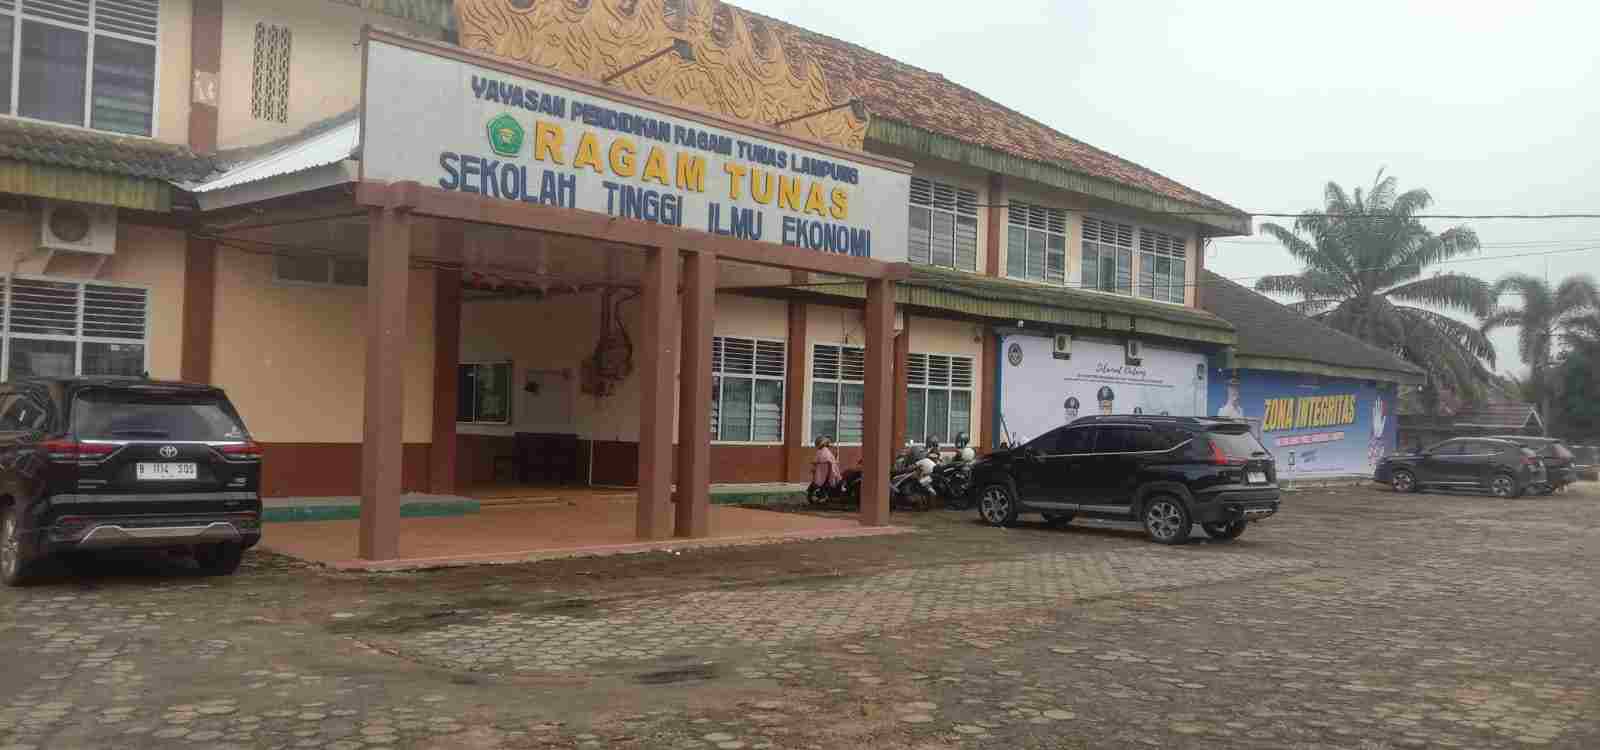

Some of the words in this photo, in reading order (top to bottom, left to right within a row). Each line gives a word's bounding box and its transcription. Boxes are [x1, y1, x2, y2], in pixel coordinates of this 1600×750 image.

[471, 75, 566, 119] YAYASAN
[570, 101, 671, 144] PENDIDIKAN
[673, 120, 733, 157] RAGAM
[736, 139, 788, 170] TUNAS
[790, 152, 859, 185] LAMPUNG
[534, 119, 705, 194] RAGAM
[722, 160, 848, 219] TUNAS
[439, 151, 576, 209] SEKOLAH
[602, 180, 684, 228] TINGGI
[708, 202, 763, 241] ILMU
[782, 215, 872, 258] EKONOMI
[1263, 398, 1295, 432] ZONA
[1296, 394, 1356, 428] INTEGRITAS
[138, 463, 144, 474] B
